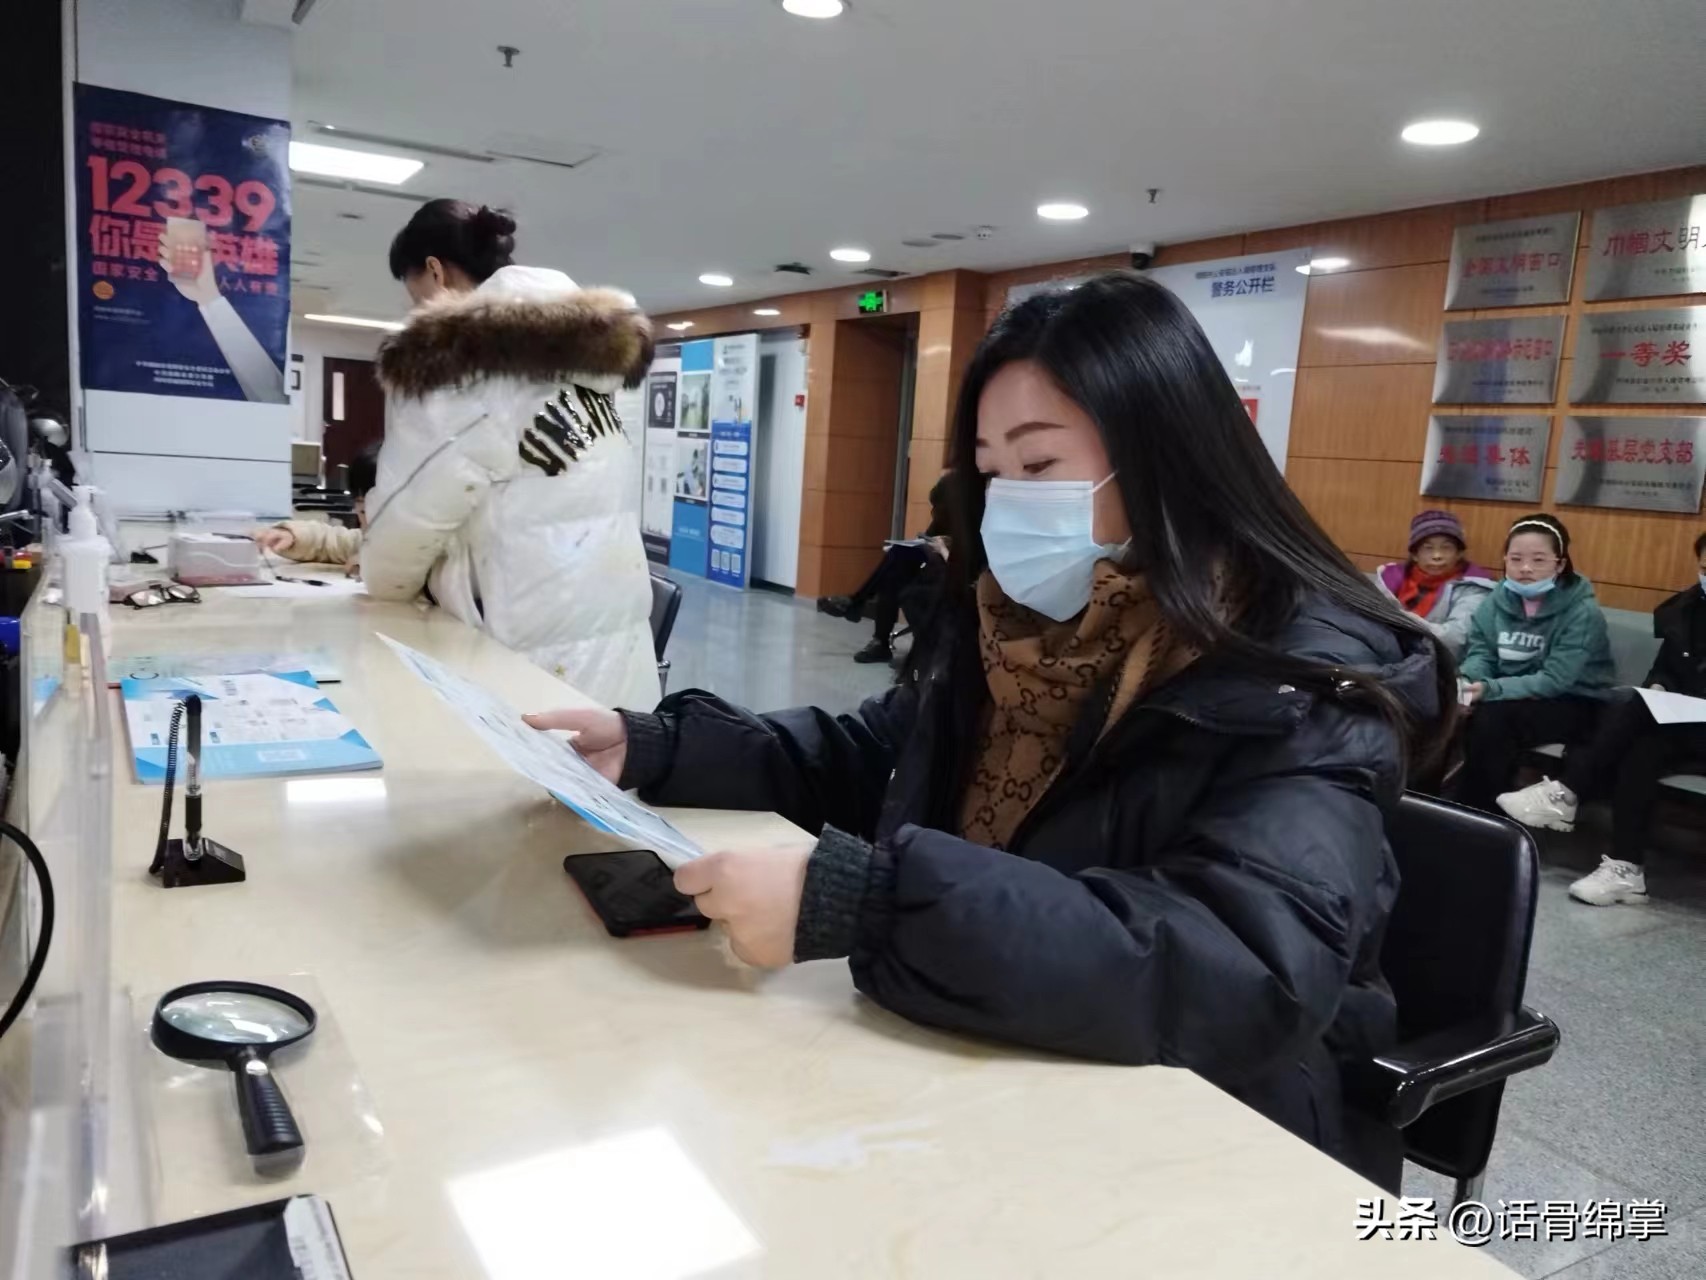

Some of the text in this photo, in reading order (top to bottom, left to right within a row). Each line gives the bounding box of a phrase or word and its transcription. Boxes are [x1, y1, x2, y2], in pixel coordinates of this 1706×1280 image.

[87, 155, 276, 232] 12339
[1602, 224, 1706, 257] 巾帼文明
[1599, 340, 1692, 367] 一等奖
